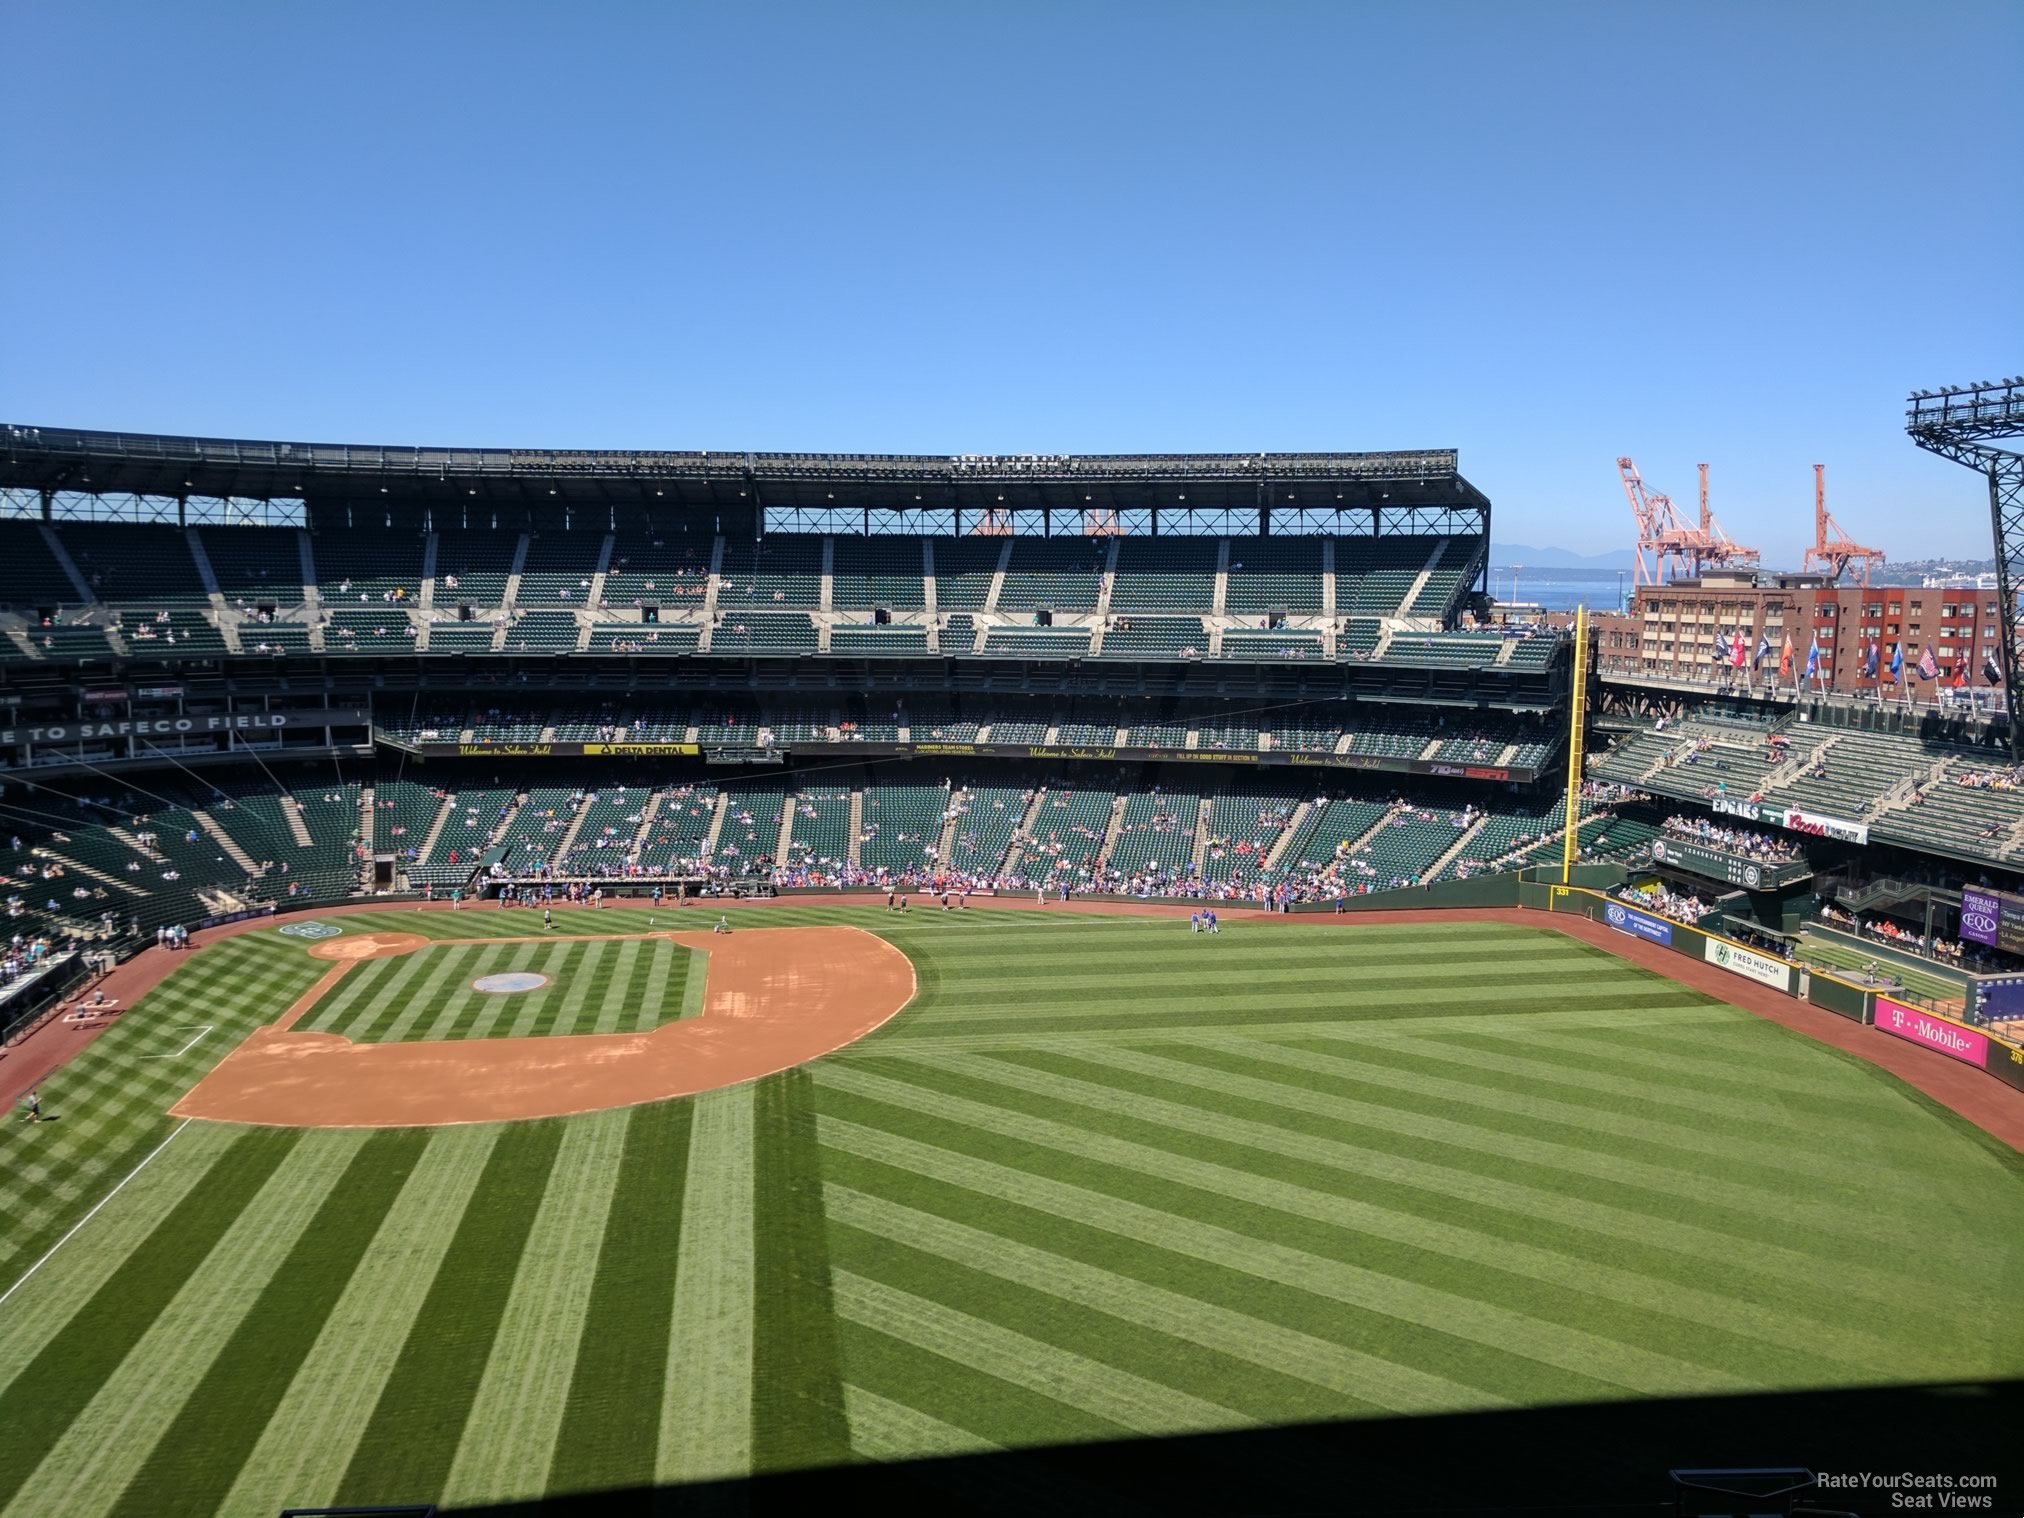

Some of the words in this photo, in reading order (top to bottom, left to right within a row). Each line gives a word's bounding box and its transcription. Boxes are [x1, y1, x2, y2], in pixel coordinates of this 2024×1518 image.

[28, 727, 66, 740] TO
[80, 719, 193, 737] SAFECO
[208, 715, 287, 729] FIELD
[459, 745, 492, 755] Welcome
[501, 745, 528, 755] Safeco
[529, 745, 552, 755] Field
[615, 746, 643, 754] DELTA
[645, 746, 684, 754] DENTAL
[1029, 747, 1059, 758] Welcome
[1060, 750, 1067, 758] to
[1068, 748, 1093, 758] Safeco
[1094, 748, 1116, 759] Field
[1290, 754, 1323, 765] Welcome
[1430, 764, 1451, 775] 710
[1465, 767, 1510, 780] ESPN
[1789, 814, 1825, 836] Coors
[1674, 850, 1683, 858] York
[1556, 887, 1569, 896] 331
[1964, 894, 1999, 909] EMERALD
[1968, 902, 1993, 914] QUEEN
[1963, 913, 1997, 932] EQC
[1968, 931, 1988, 940] CASINO
[1733, 952, 1752, 965] FRED
[1753, 960, 1779, 975] HUTCH
[2010, 1050, 2023, 1065] 376
